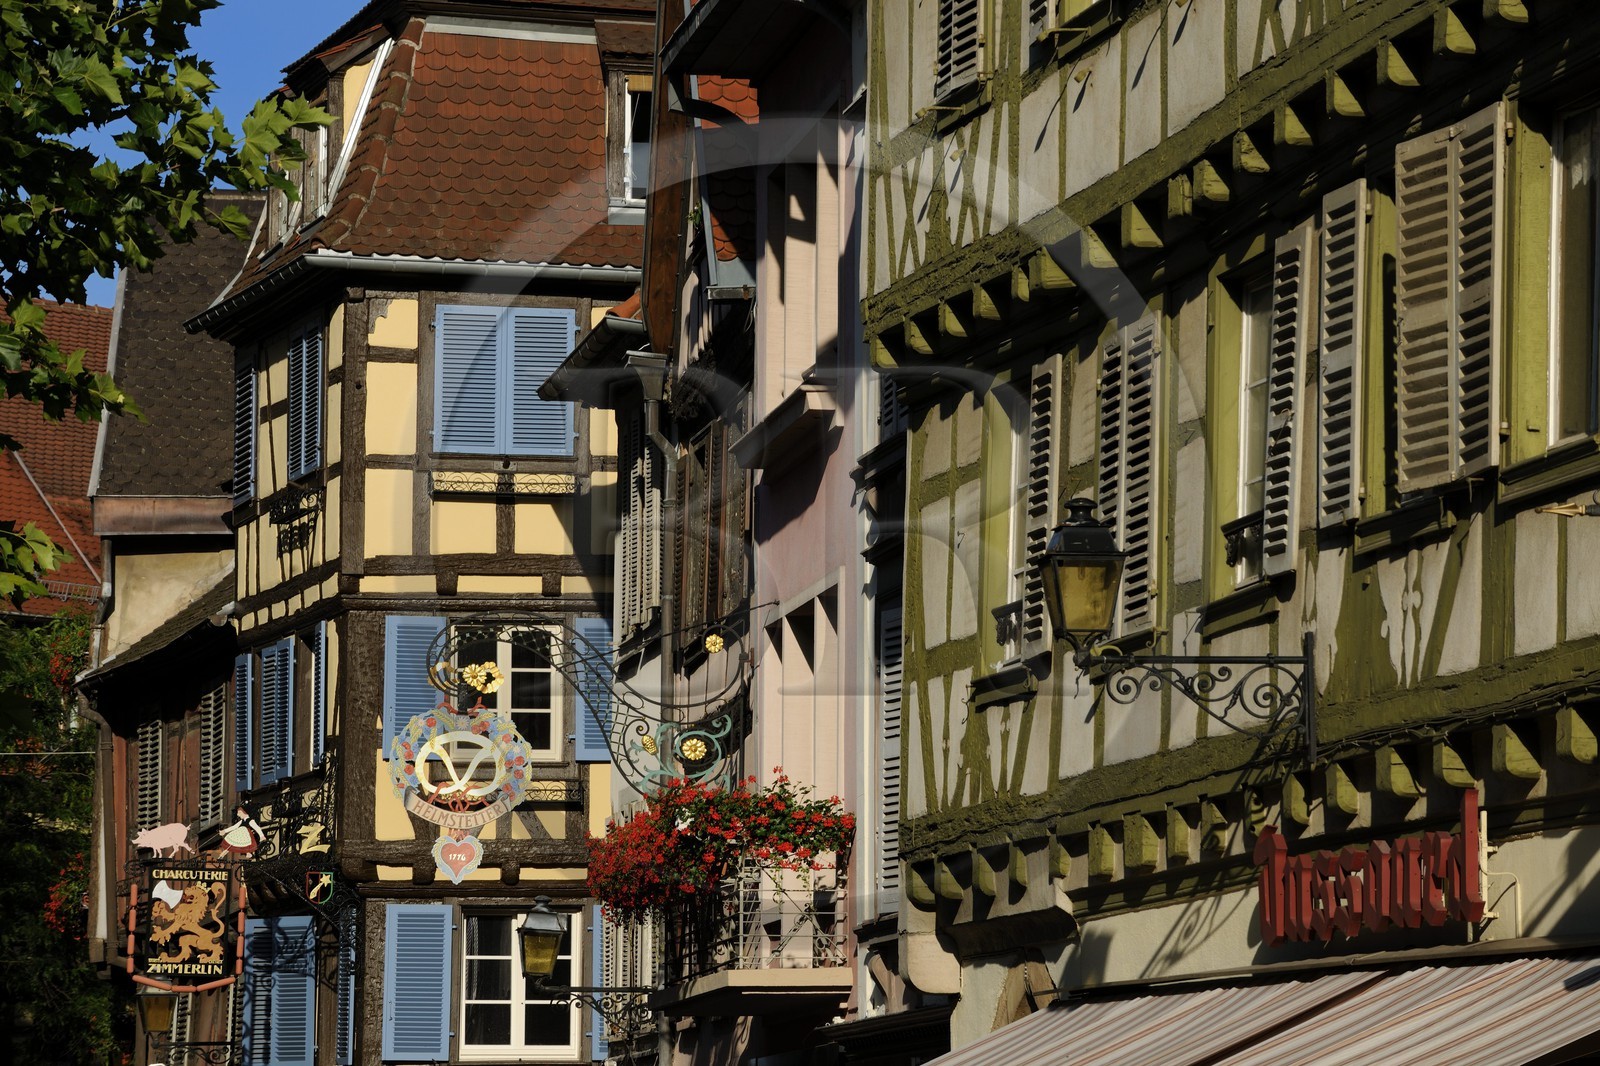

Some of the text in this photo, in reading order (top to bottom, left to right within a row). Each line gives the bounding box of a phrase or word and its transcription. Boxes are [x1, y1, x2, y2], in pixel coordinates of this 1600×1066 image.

[413, 798, 504, 829] HELMSTETTER
[152, 869, 229, 882] CHARCUTERIE
[146, 963, 223, 975] ZIMMERLIN
